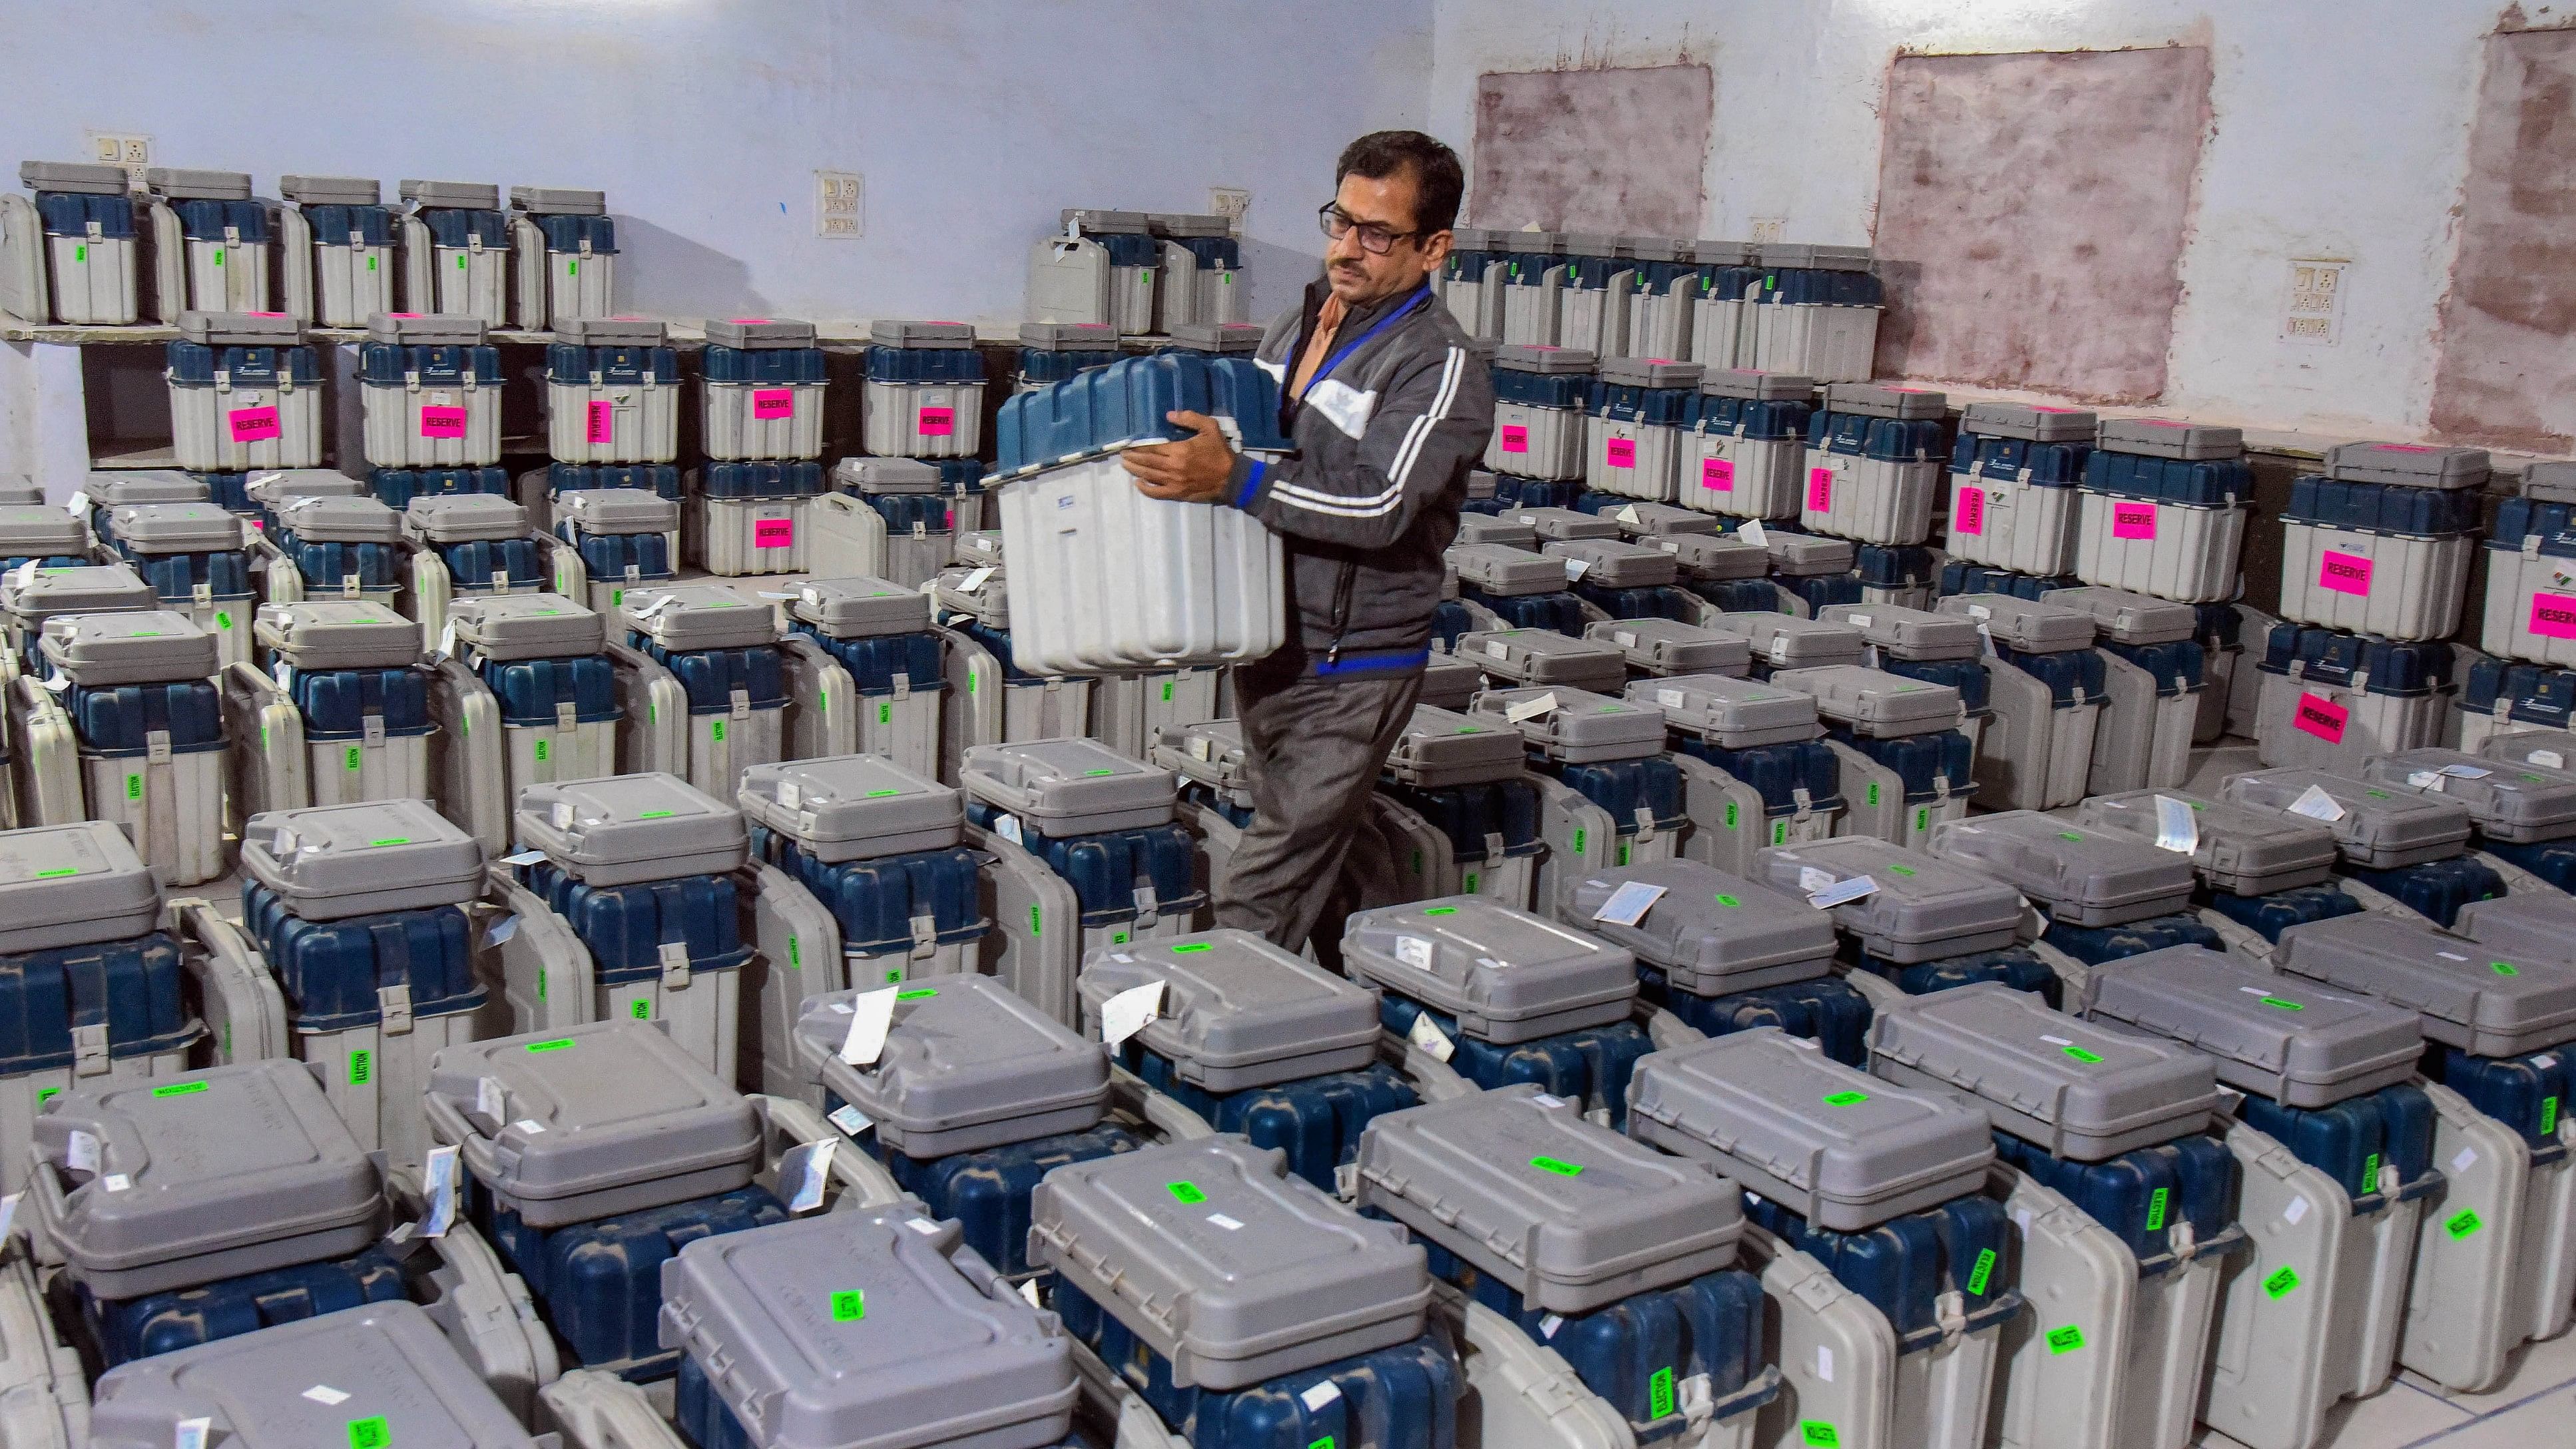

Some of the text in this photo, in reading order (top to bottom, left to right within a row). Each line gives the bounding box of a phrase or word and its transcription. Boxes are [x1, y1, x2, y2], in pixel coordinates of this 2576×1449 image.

[758, 400, 788, 409] RESERVE
[236, 418, 274, 430] RESERVE
[426, 417, 460, 427] RESERVE
[591, 405, 601, 438] RESERVE
[923, 416, 949, 425] RESERVE
[1706, 468, 1729, 480] RESERVE
[1969, 492, 1979, 527] RESERVE
[2119, 513, 2151, 525] RESERVE
[2328, 562, 2366, 581] RESERVE
[2538, 608, 2576, 623] RESER
[2302, 707, 2340, 730] RESERVE
[130, 776, 139, 796] ELECTION
[356, 1053, 367, 1081] ELECTION
[2149, 1191, 2163, 1226] ELECTION
[1971, 1253, 1990, 1289] ELECTION
[1656, 1373, 1666, 1412] ELECTION
